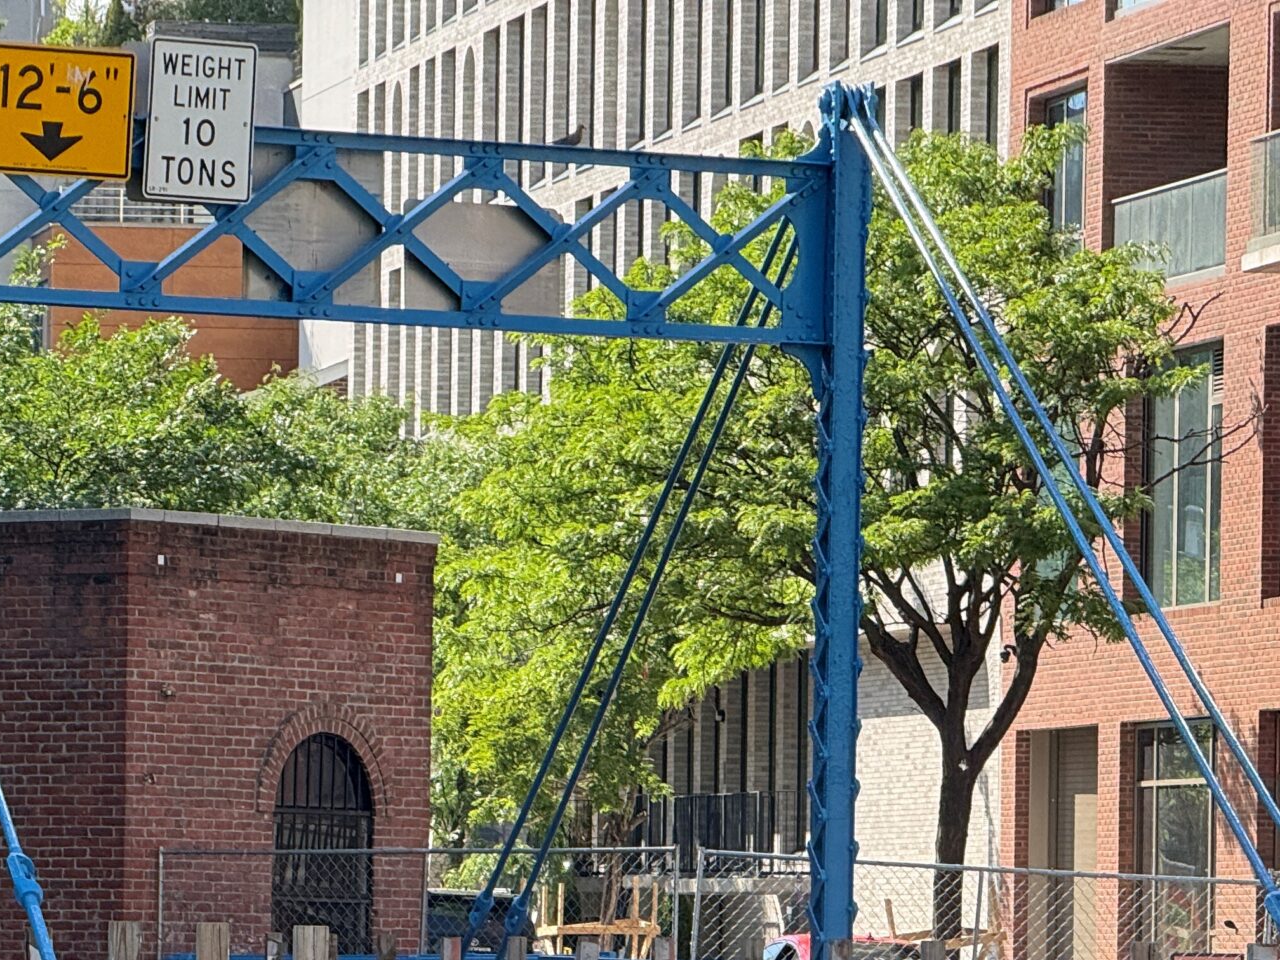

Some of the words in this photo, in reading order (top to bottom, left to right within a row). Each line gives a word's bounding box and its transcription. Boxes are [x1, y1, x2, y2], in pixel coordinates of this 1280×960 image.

[163, 52, 246, 81] WEIGHT
[0, 63, 119, 115] 12'-6"
[173, 84, 231, 111] LIMIT
[182, 117, 216, 147] 10
[161, 155, 236, 189] TONS
